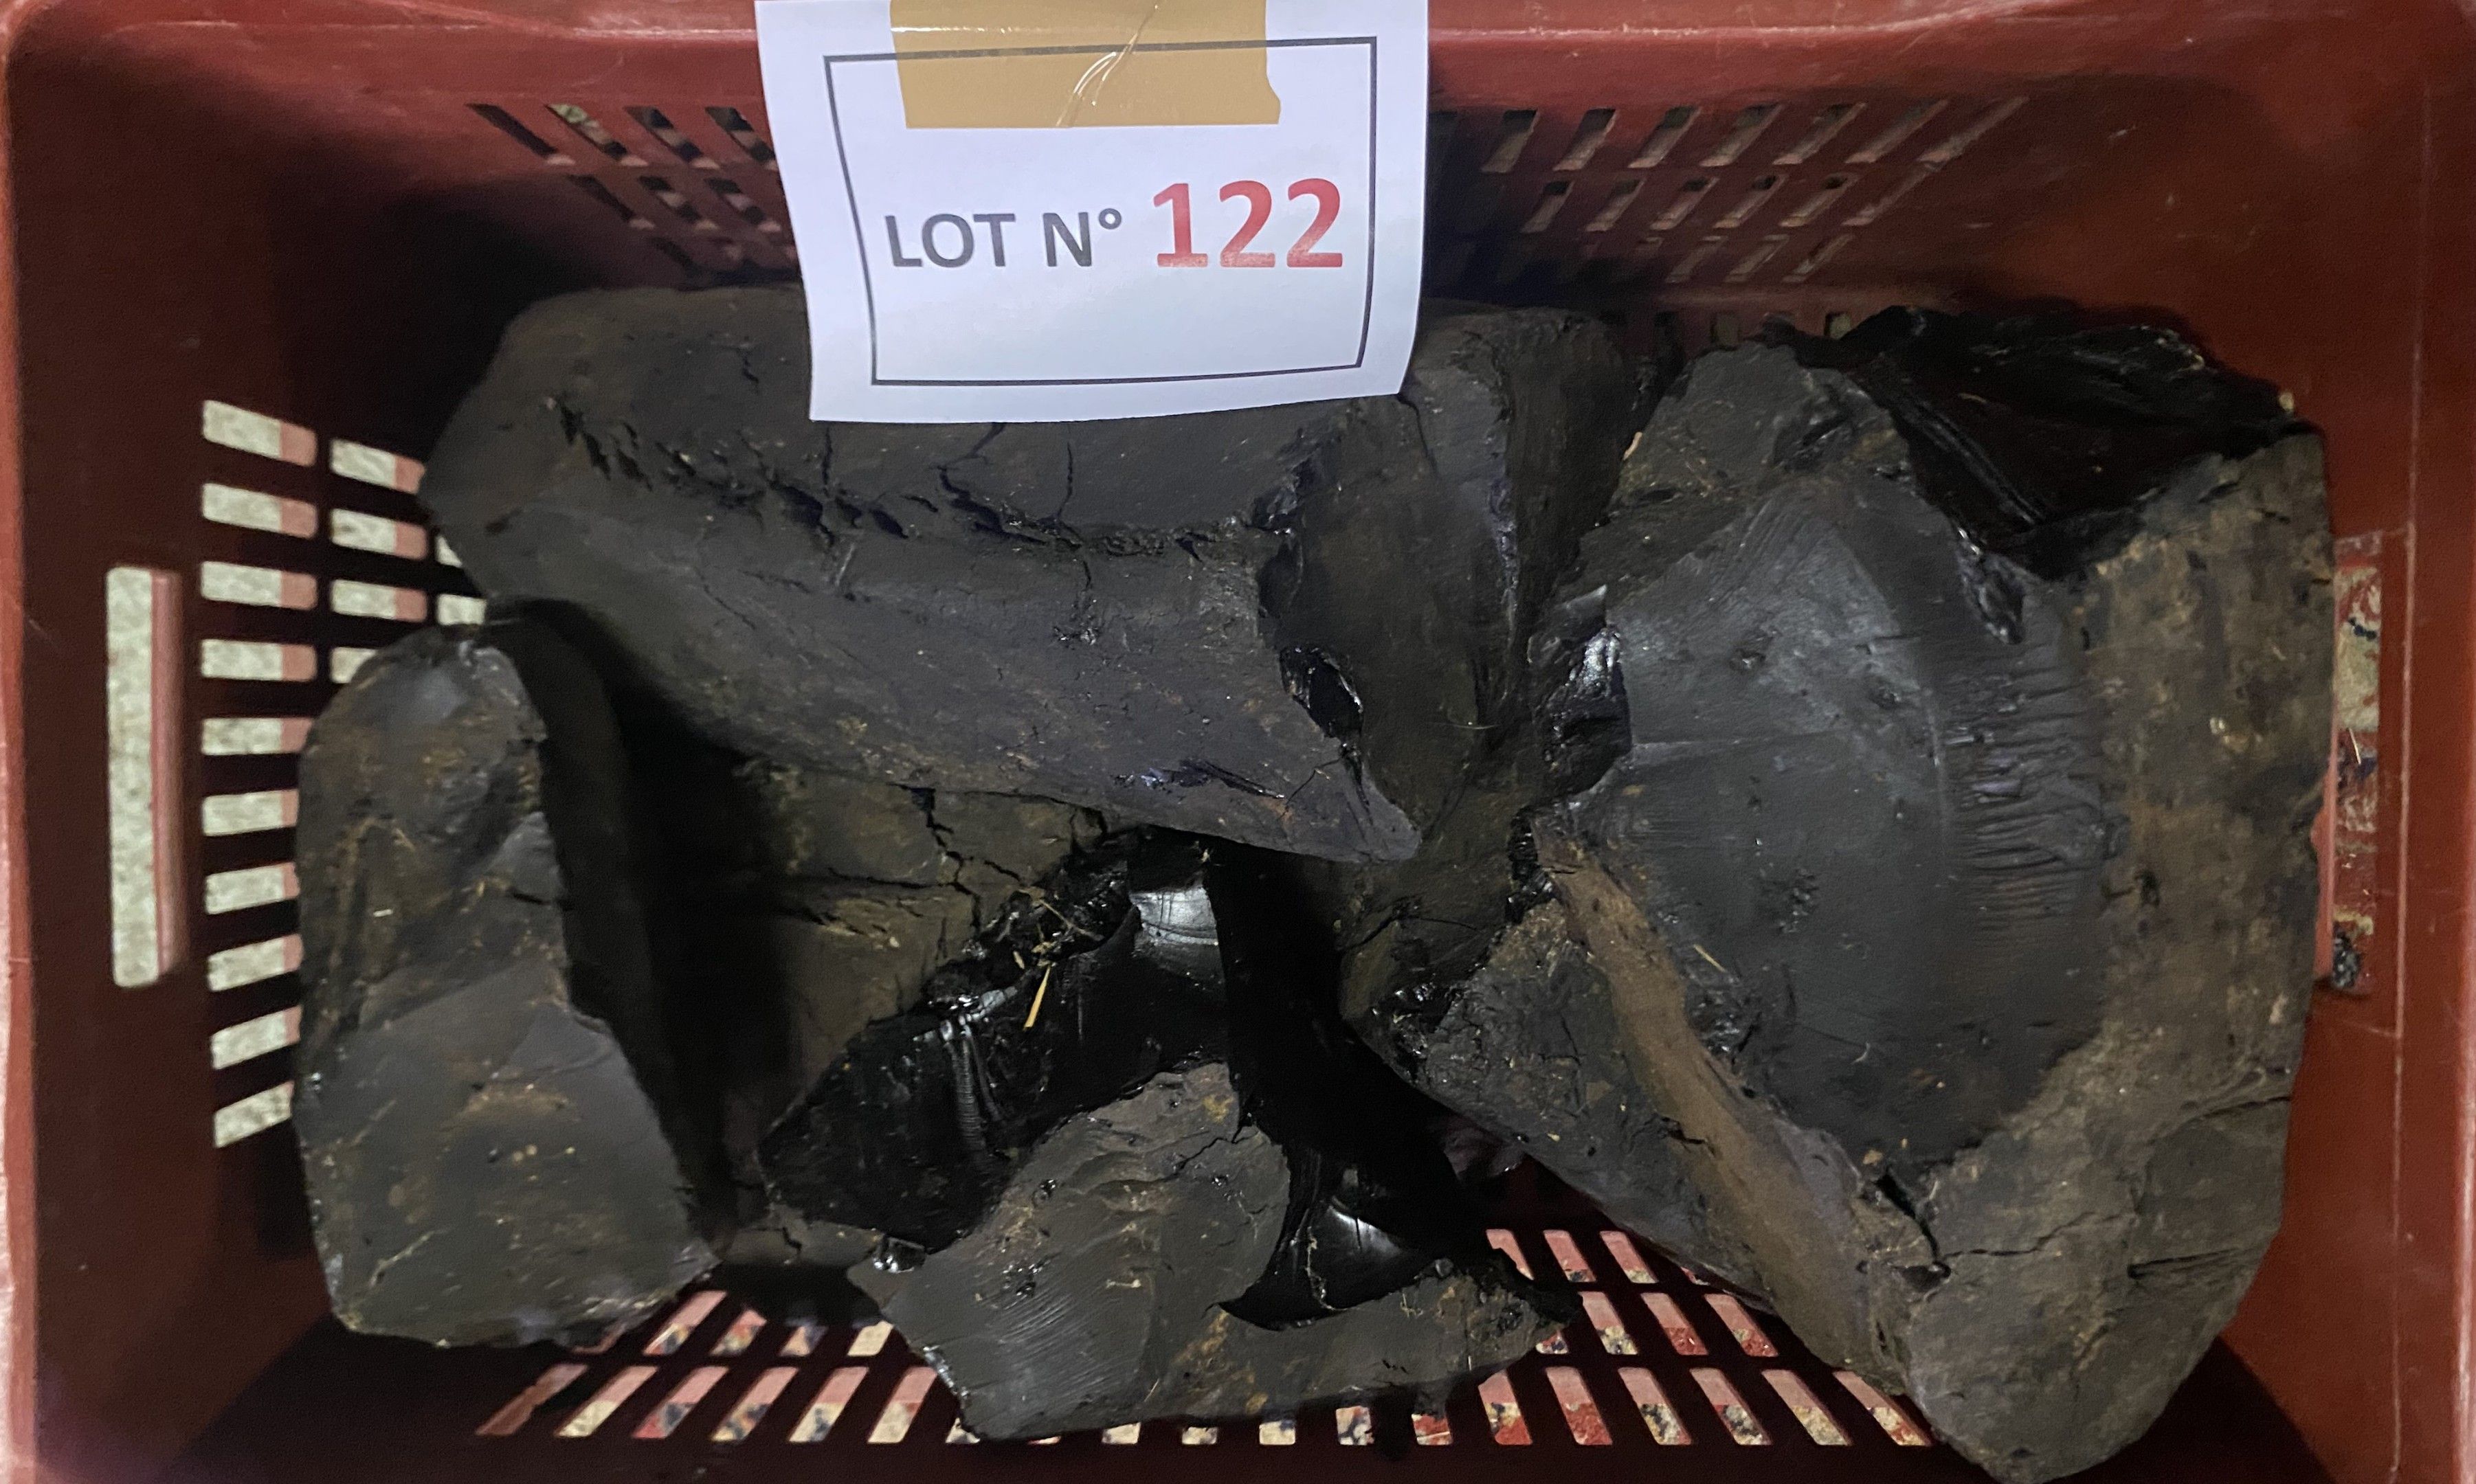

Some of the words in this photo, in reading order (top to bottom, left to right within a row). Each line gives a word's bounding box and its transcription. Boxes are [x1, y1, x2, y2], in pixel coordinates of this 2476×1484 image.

[884, 213, 1016, 268] LOT
[1043, 207, 1123, 268] N°
[1152, 177, 1343, 269] 122
